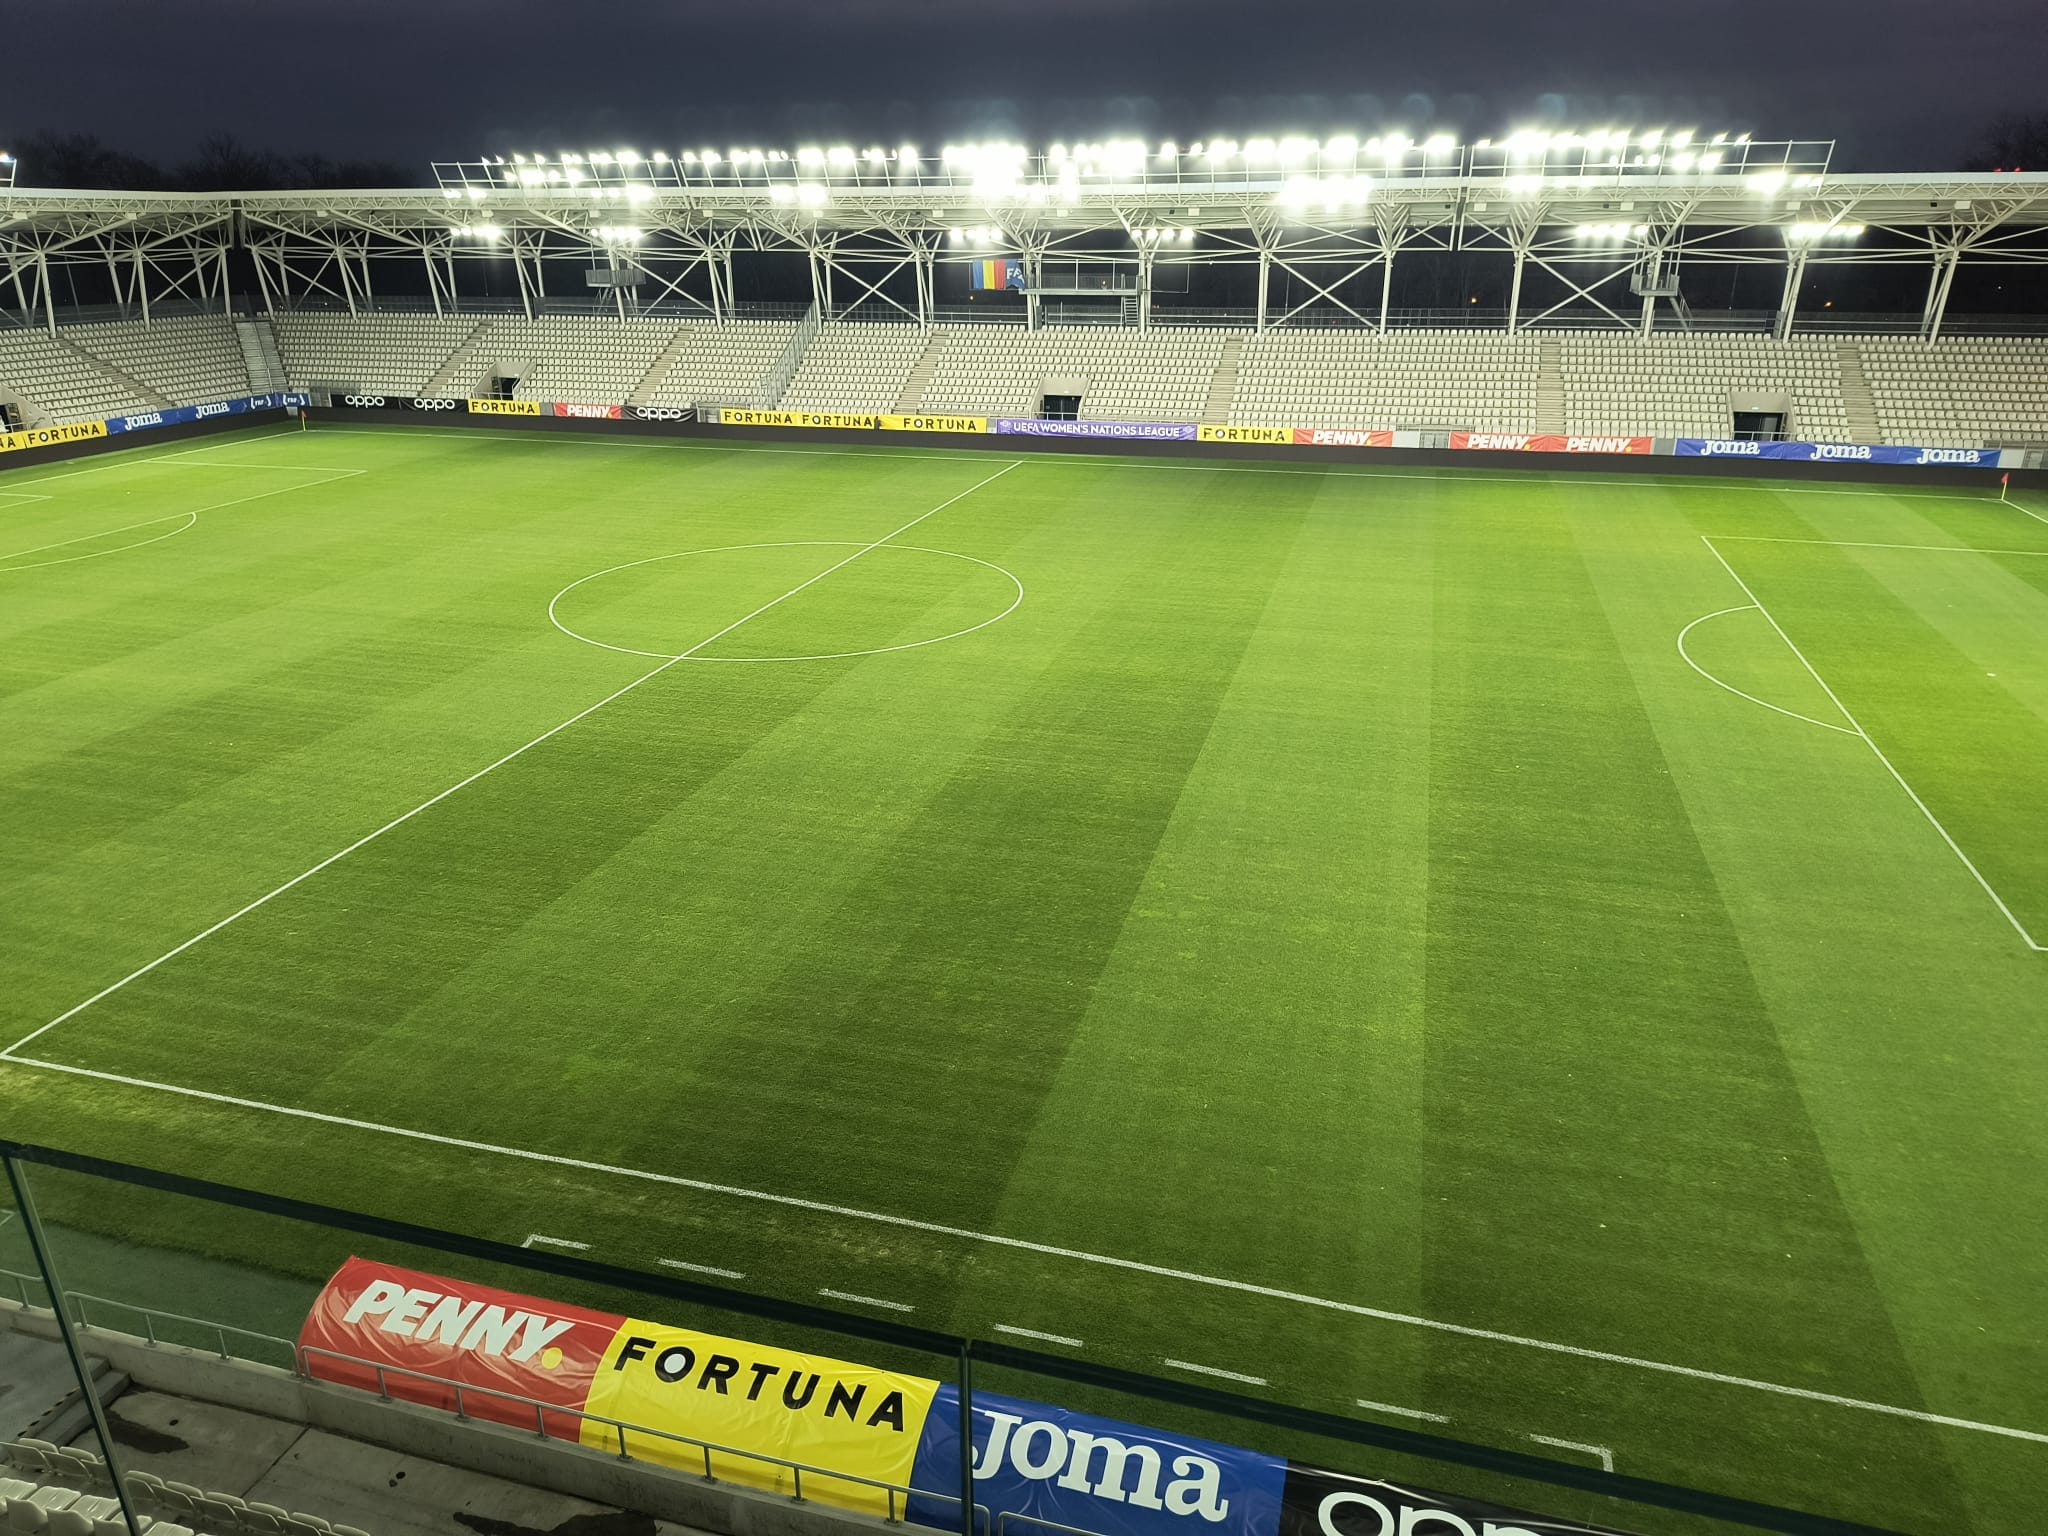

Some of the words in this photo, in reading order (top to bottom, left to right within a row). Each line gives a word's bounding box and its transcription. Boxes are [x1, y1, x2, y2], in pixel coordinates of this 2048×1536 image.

[345, 395, 385, 408] oppo
[414, 397, 455, 411] oppo
[472, 401, 535, 414] FORTUNA
[636, 406, 681, 421] oppo
[725, 411, 792, 424] FORTUNA
[802, 414, 872, 427] FORTUNA
[903, 417, 976, 431] FORTUNA
[1013, 422, 1039, 432] UEFA
[1090, 425, 1136, 435] NATIONS
[1138, 426, 1180, 437] LEAGUE
[28, 424, 100, 444] FORTUNA
[1203, 428, 1285, 442] FORTUNA
[613, 1336, 905, 1433] FORTUNA
